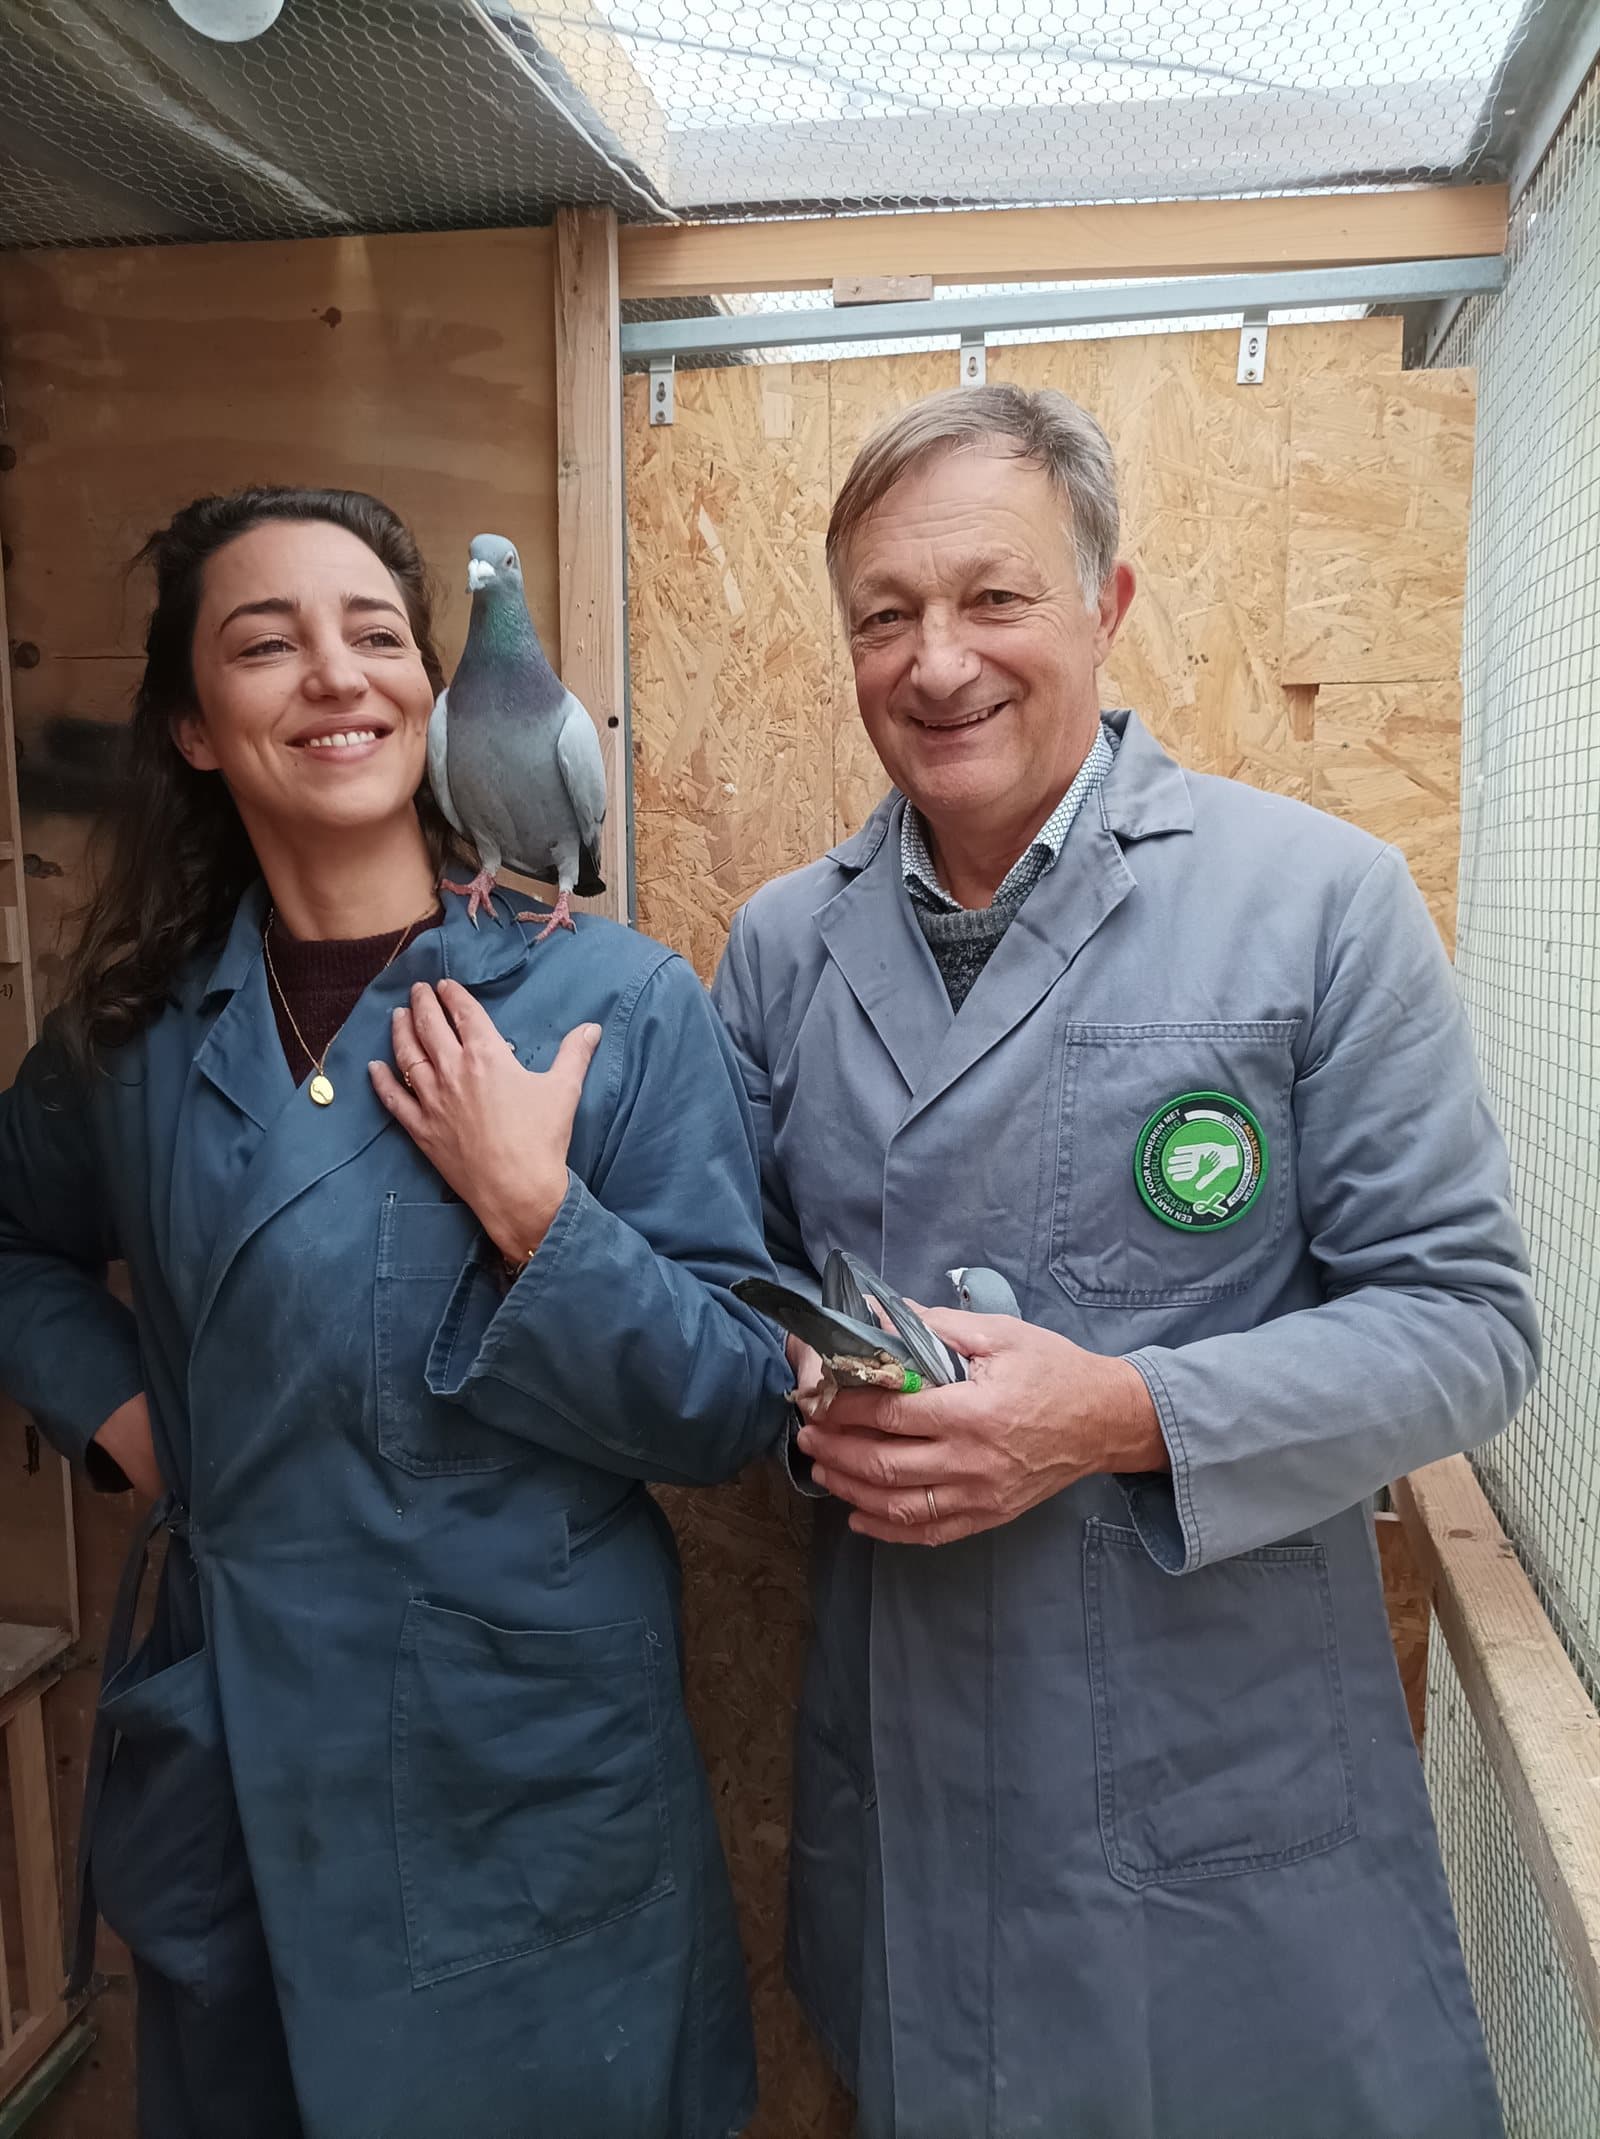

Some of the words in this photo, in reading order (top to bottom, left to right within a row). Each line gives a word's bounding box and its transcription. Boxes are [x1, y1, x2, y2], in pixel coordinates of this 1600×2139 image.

[1163, 1109, 1180, 1124] MET
[1143, 1122, 1165, 1167] KINDEREN
[1151, 1119, 1191, 1213] HERSENVERLAMMING
[1143, 1169, 1156, 1196] VOOR
[1153, 1195, 1174, 1215] HART
[1174, 1211, 1192, 1223] EEN
